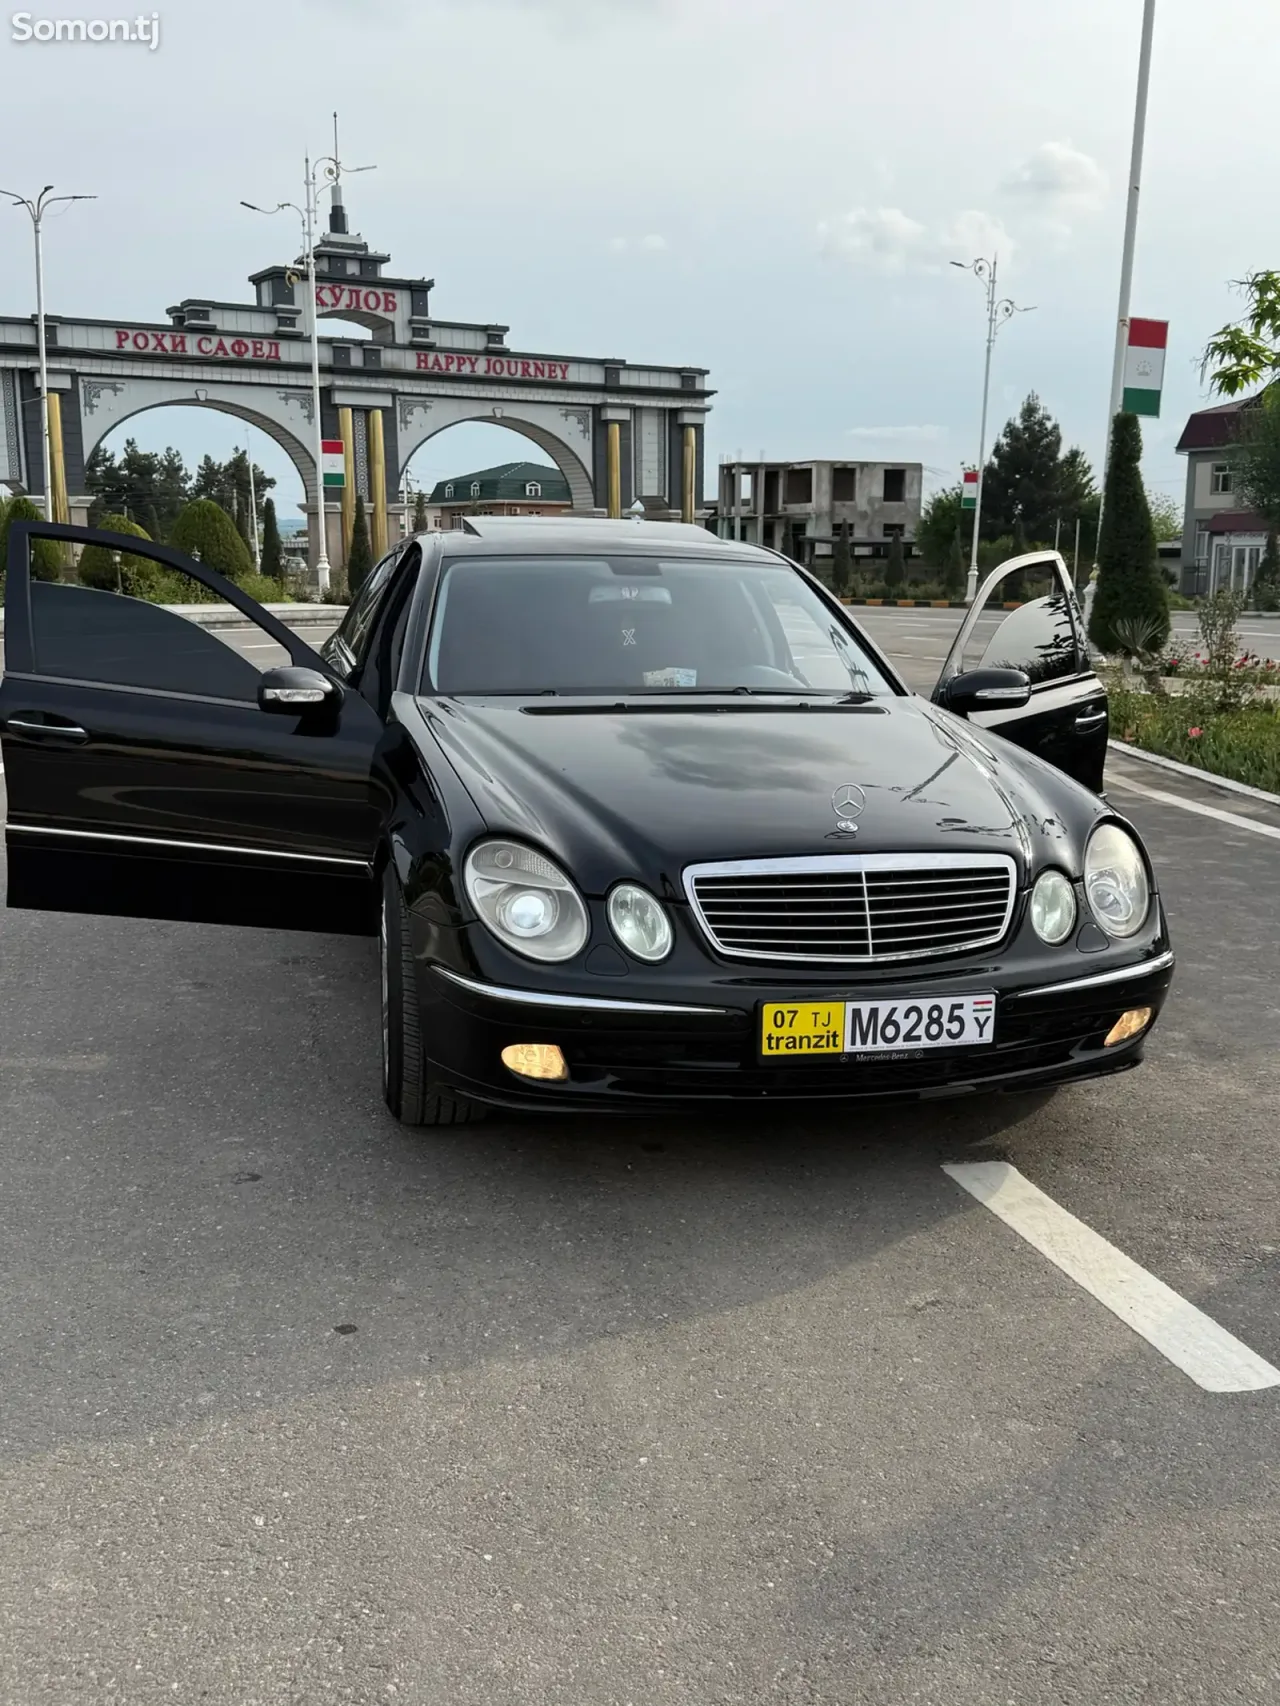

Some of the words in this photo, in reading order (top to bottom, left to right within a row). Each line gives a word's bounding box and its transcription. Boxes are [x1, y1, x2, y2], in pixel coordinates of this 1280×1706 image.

[197, 336, 281, 360] САФЕД
[416, 352, 479, 374] HAPPY
[484, 357, 569, 380] JOURNEY
[773, 1010, 799, 1029] 07
[811, 1011, 831, 1028] TJ
[850, 1003, 965, 1047] M6285
[973, 1015, 990, 1038] Y
[766, 1030, 839, 1051] tranzit
